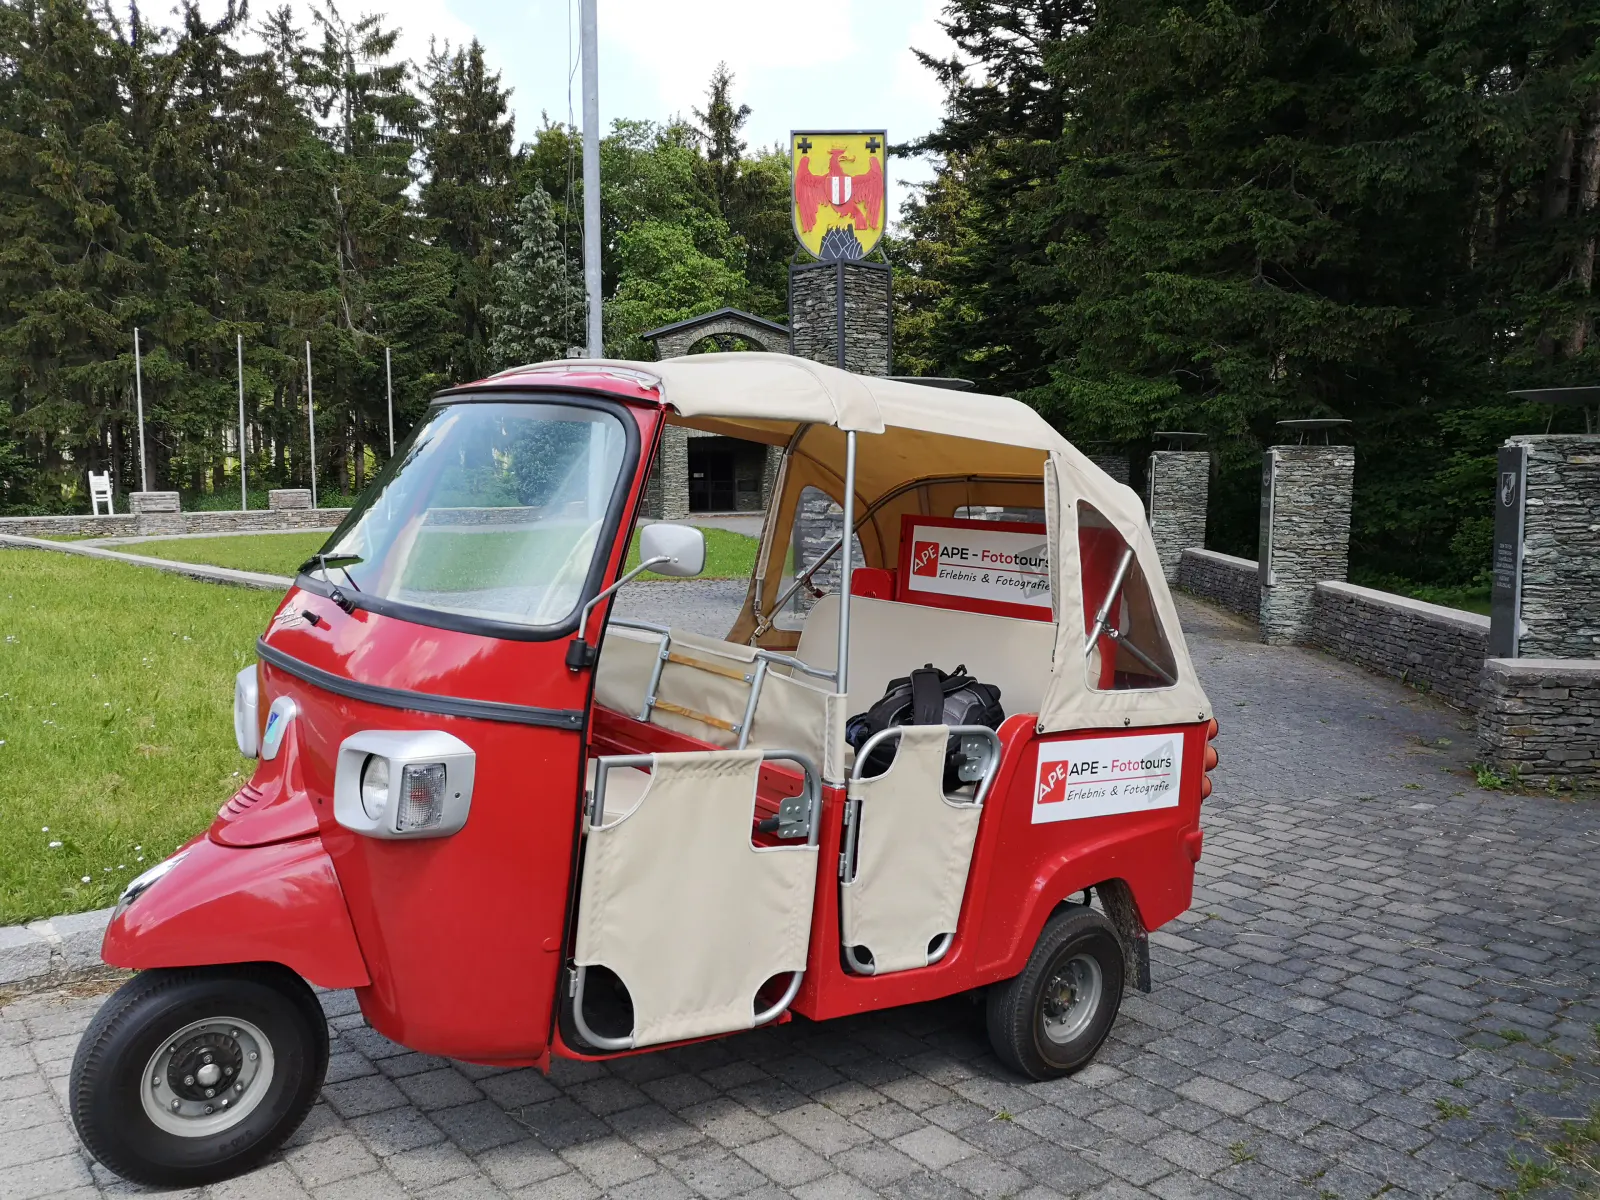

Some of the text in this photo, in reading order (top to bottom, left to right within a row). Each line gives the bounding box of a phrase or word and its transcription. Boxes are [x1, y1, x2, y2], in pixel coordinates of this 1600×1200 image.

[914, 544, 937, 572] APE
[940, 546, 969, 560] APE
[939, 569, 1050, 591] Erlebnis & Fotografie
[1069, 761, 1099, 777] APE
[1111, 757, 1172, 773] Fototours
[1038, 763, 1067, 801] APE
[1067, 780, 1170, 801] Erlebnis & Fotografie
